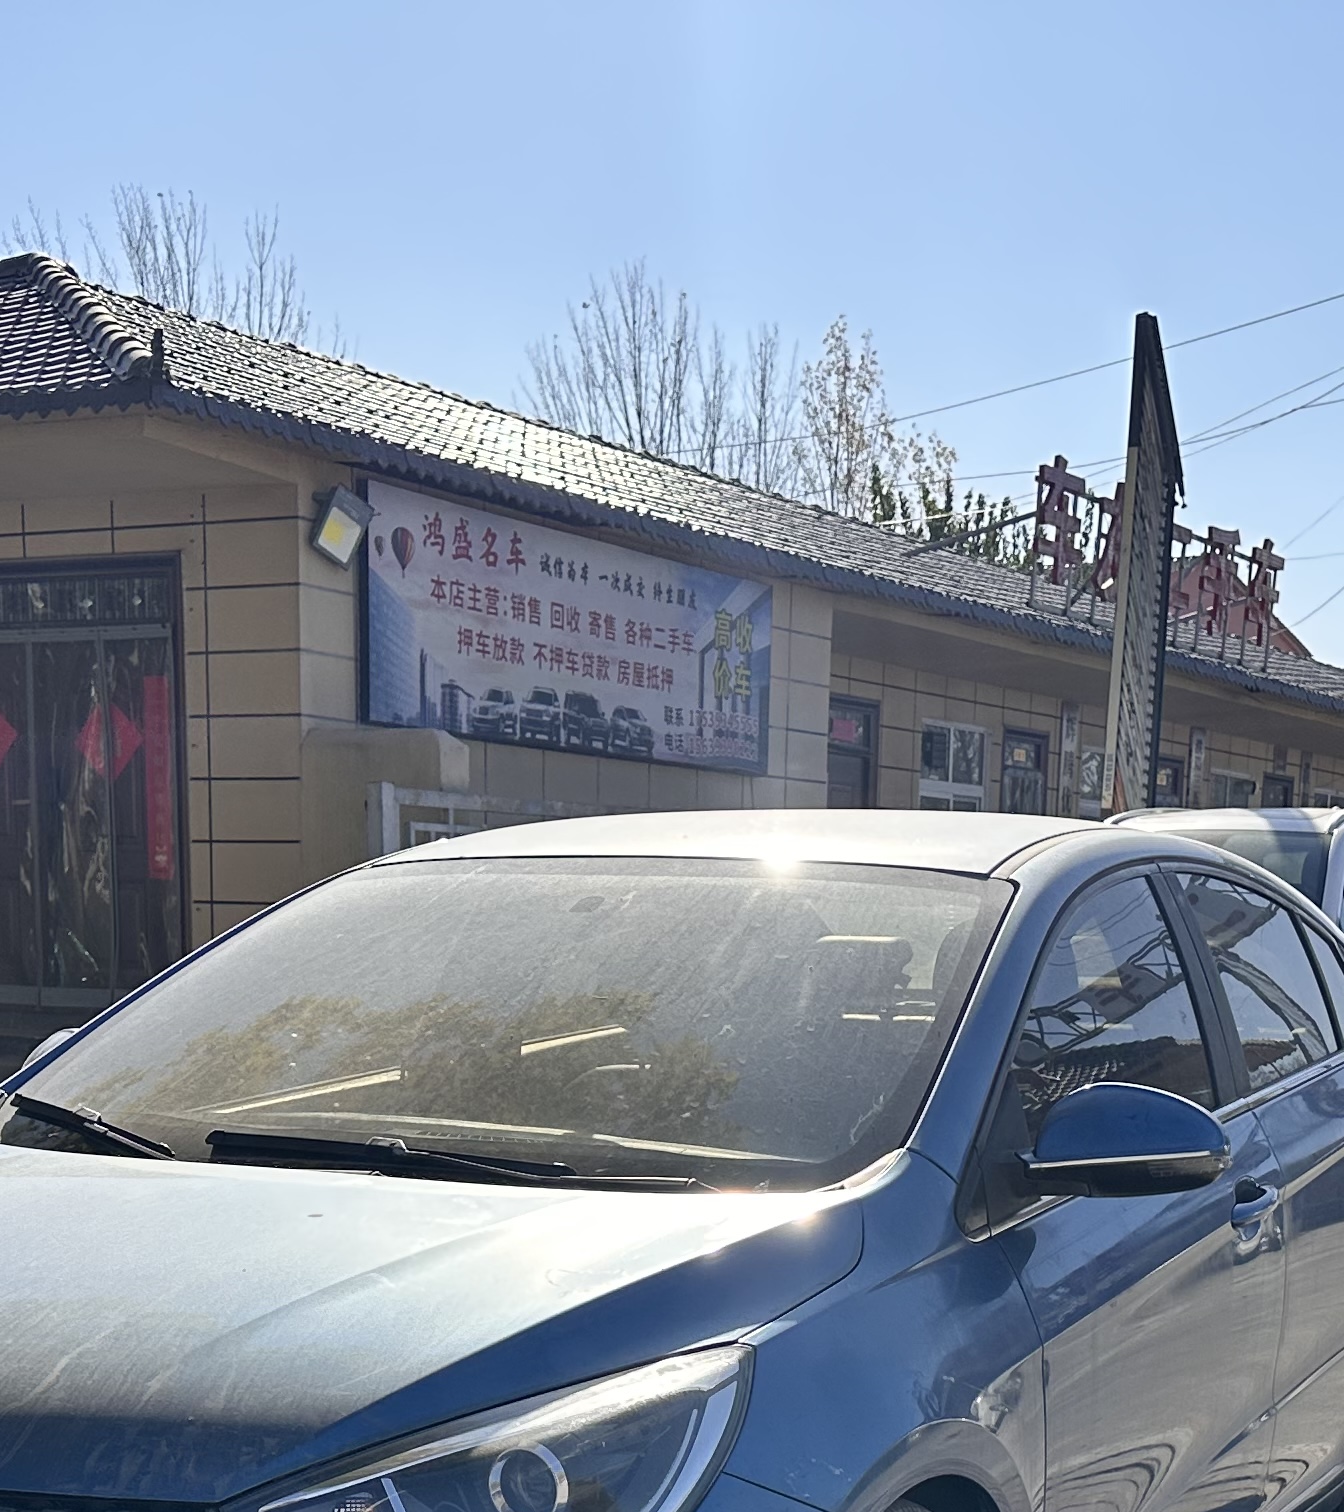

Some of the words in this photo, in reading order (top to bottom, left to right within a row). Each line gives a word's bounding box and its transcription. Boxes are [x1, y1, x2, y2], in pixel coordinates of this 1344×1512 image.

[422, 511, 527, 577] 鸿盛名车
[456, 624, 526, 667] 押车放款
[532, 641, 612, 682] 不押车贷款
[616, 657, 674, 694] 房屋抵押
[549, 601, 582, 635] 回收
[587, 609, 618, 643] 寄售
[623, 616, 696, 657] 各种二手车
